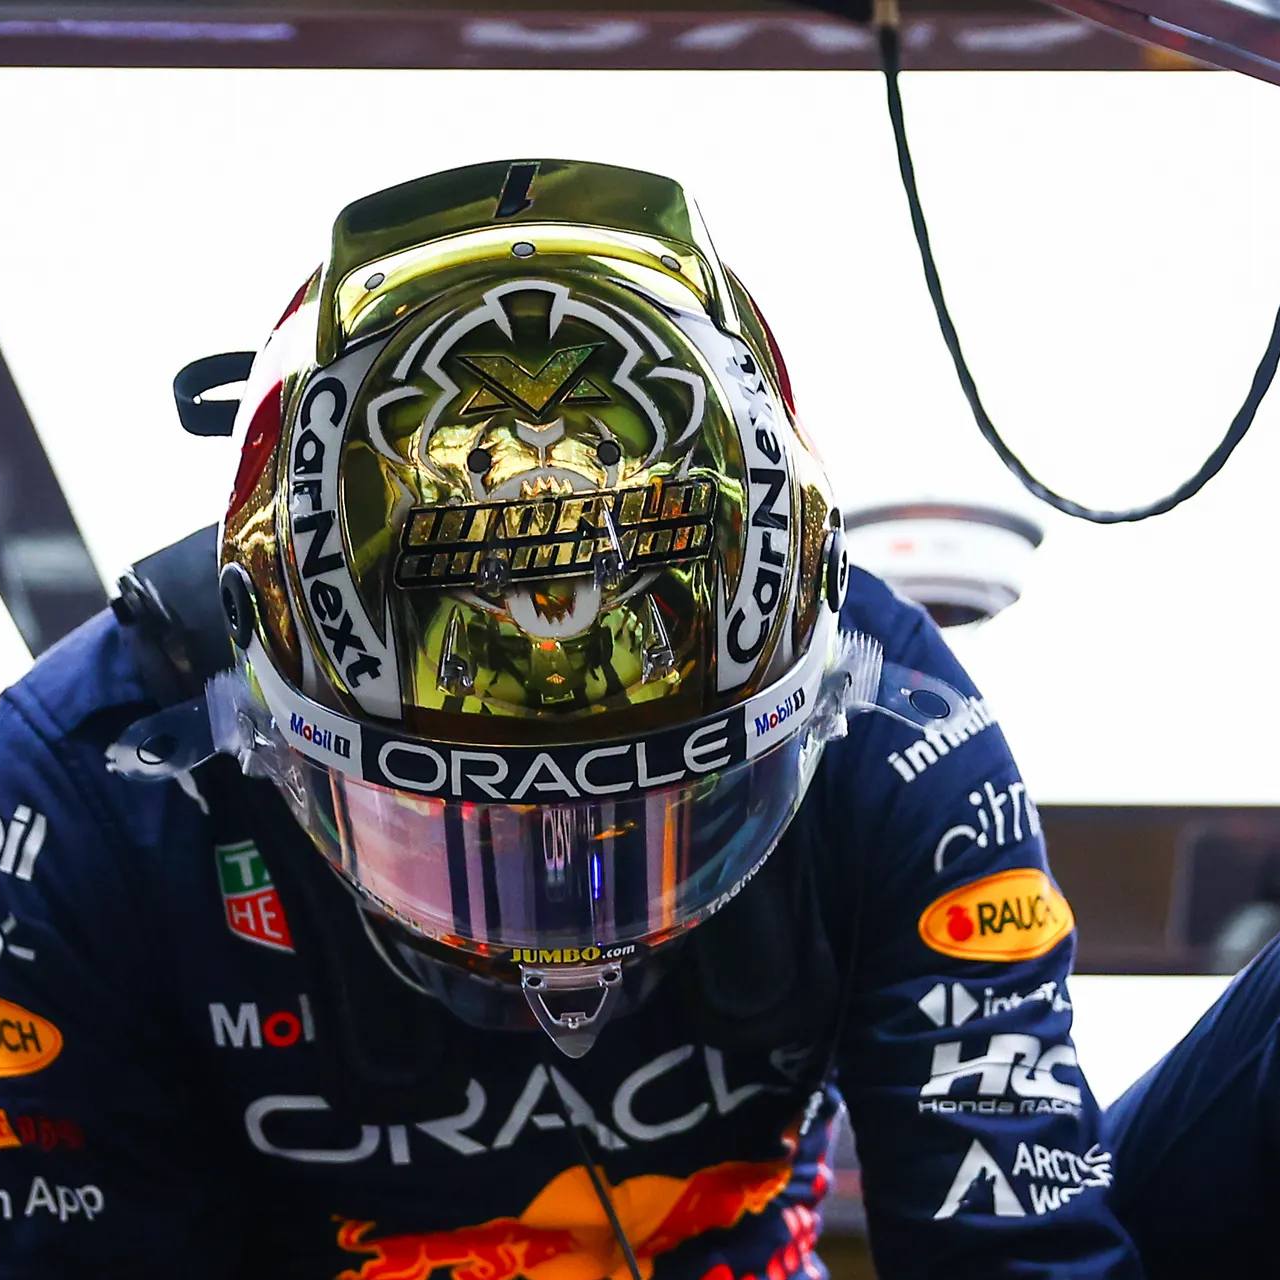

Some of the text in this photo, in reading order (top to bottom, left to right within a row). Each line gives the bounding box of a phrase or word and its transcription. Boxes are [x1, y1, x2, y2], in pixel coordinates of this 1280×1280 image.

[293, 376, 383, 689] CarNext
[290, 712, 332, 751] Mobil
[754, 696, 793, 737] Mobil
[376, 717, 732, 800] ORACLE
[510, 944, 635, 963] JUMBO.com
[920, 1033, 1081, 1105] HRC
[24, 1176, 105, 1223] App
